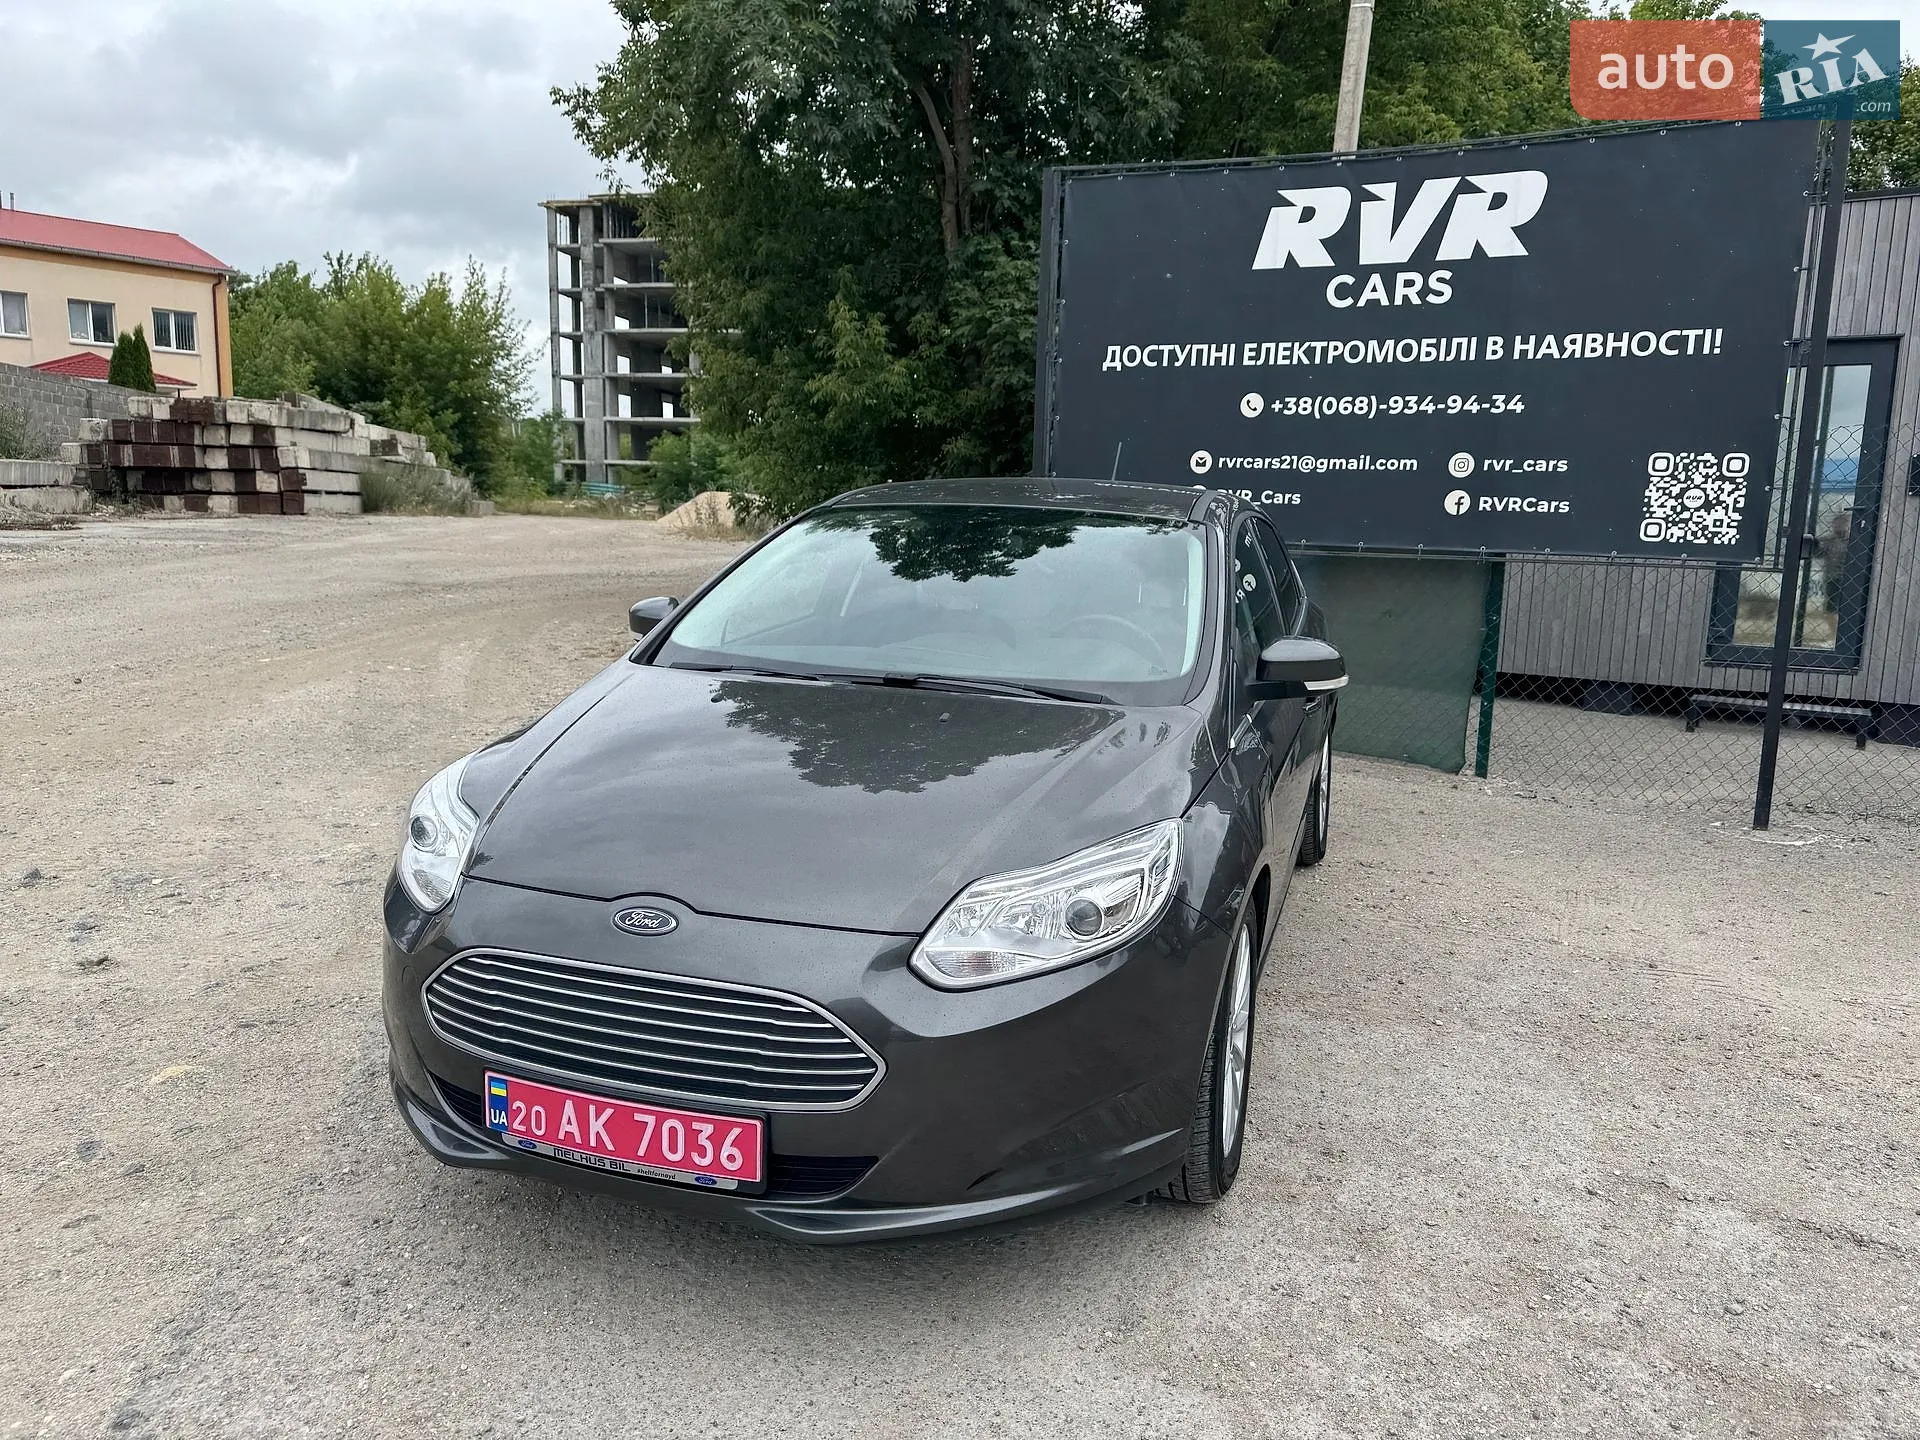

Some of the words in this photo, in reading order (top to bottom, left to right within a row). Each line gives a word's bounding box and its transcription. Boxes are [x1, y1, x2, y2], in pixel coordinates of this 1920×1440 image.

[1252, 170, 1549, 270] RVR
[1326, 269, 1453, 308] CARS
[1102, 343, 1236, 372] ДОСТУПНІ
[1242, 336, 1478, 367] ЕЛЕКТРОМОБІЛІ
[1485, 338, 1504, 361] В
[1513, 328, 1723, 361] НАЯВНОСТІ!
[1270, 394, 1526, 419] +38(068)-934-94-34
[1218, 454, 1418, 473] rvrcars21@gmail.com
[1482, 457, 1568, 474] rvr_cars
[1478, 496, 1570, 514] RVRCars
[625, 911, 662, 928] Ford
[490, 1108, 508, 1127] UA
[511, 1100, 547, 1136] 20
[557, 1099, 615, 1152] AK
[633, 1112, 744, 1171] 7036
[553, 1147, 606, 1168] MELHUS
[609, 1160, 631, 1172] BIL
